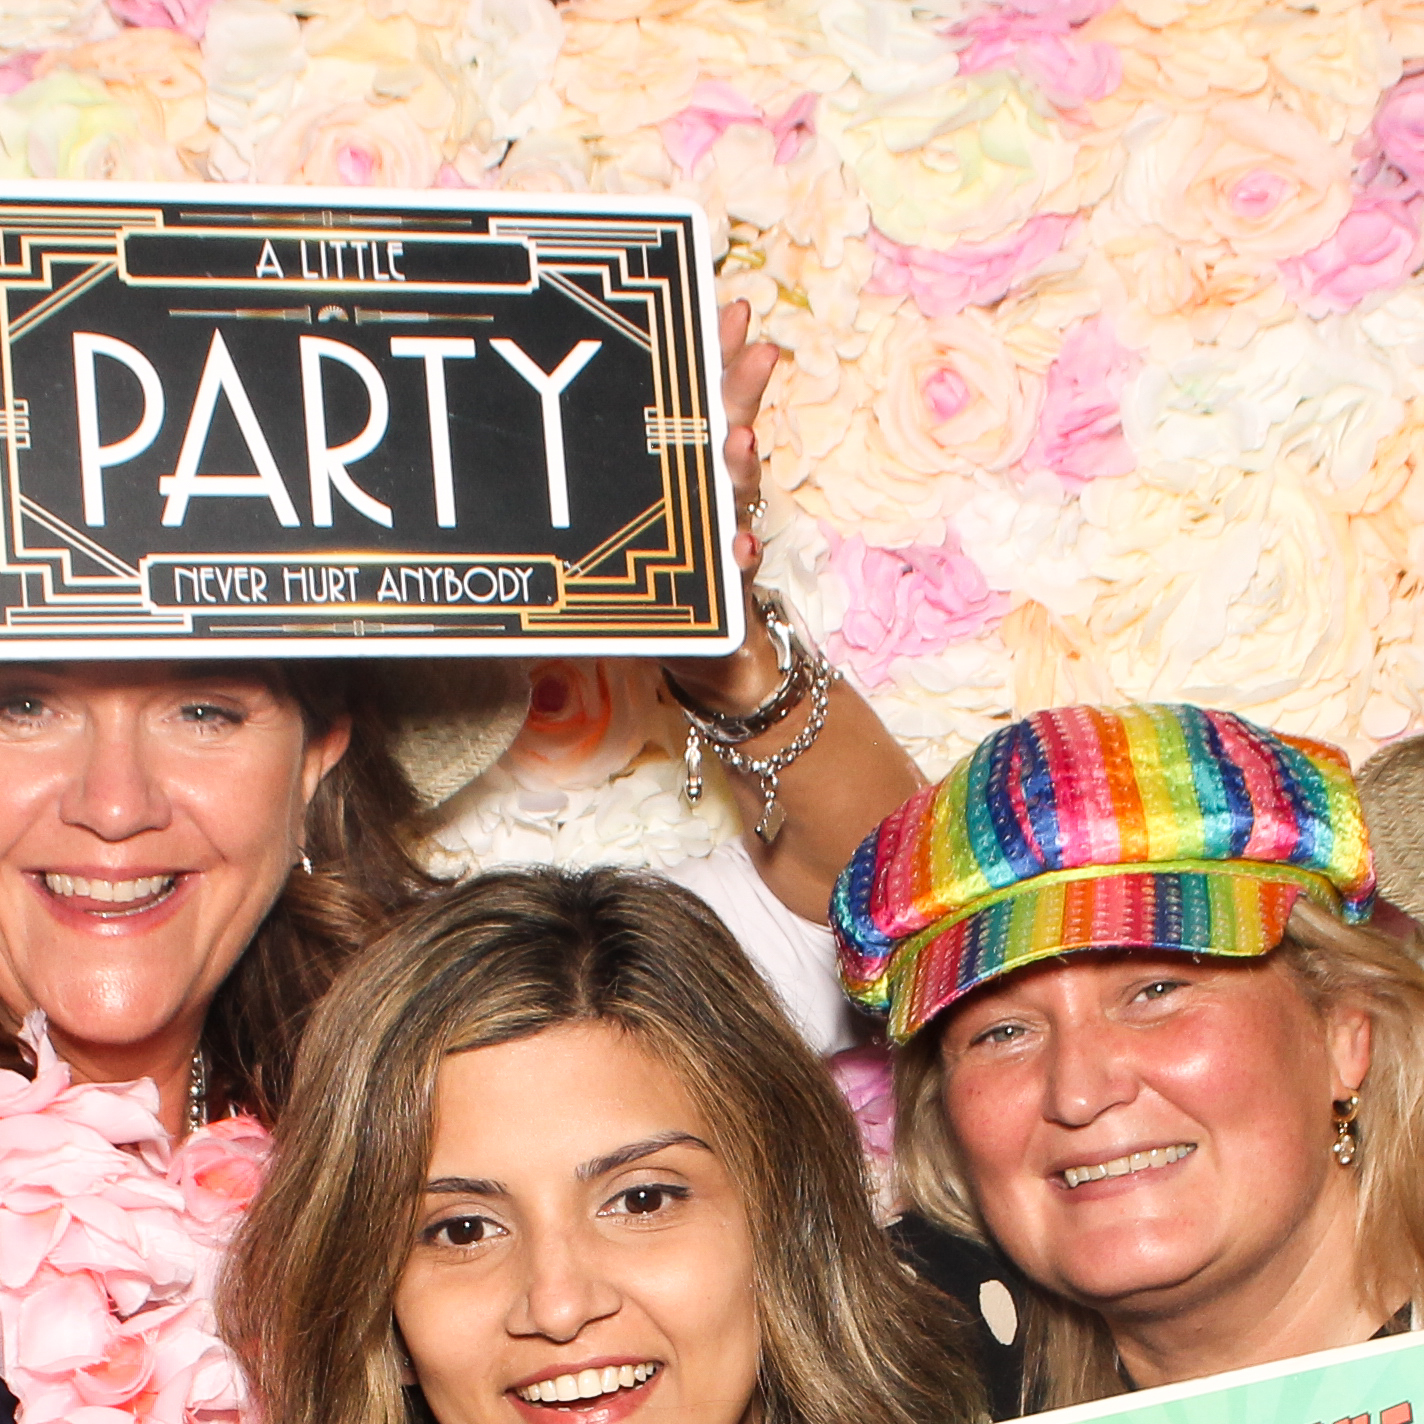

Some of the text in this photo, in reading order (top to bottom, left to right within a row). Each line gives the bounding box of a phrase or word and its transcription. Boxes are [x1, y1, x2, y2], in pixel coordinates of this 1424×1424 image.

[255, 237, 406, 281] A LITTLE
[71, 327, 603, 529] PARTY
[175, 564, 534, 605] NEVER HURT ANYBODY
